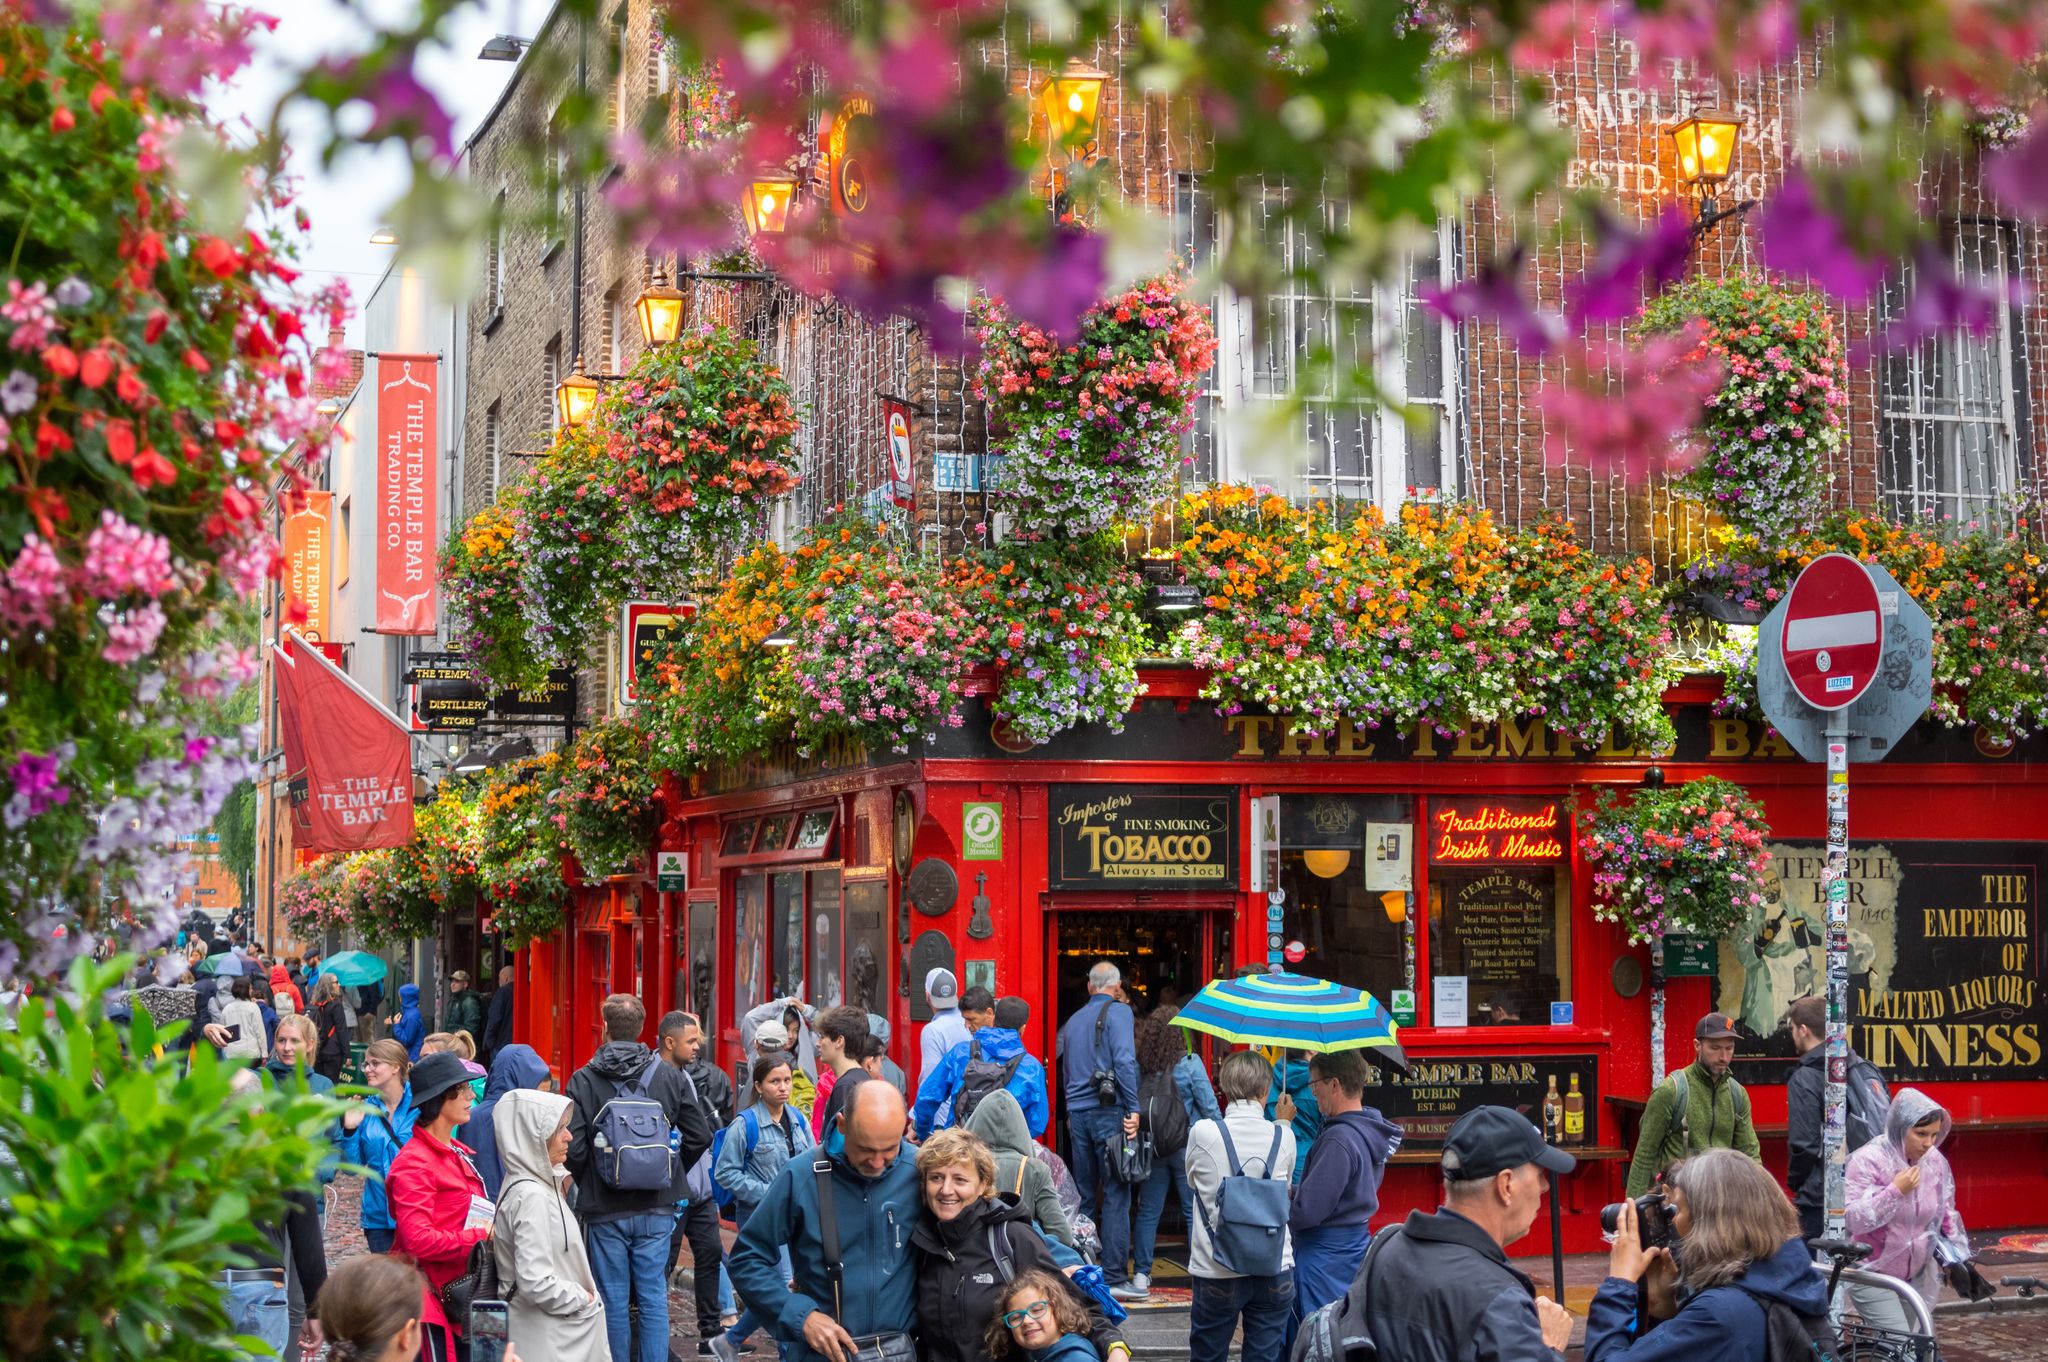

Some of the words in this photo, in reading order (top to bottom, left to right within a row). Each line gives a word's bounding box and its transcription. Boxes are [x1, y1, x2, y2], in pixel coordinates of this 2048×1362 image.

[1566, 160, 1669, 195] ESTD.
[407, 400, 423, 443] THE
[387, 431, 401, 517] TRADING
[406, 448, 423, 534] TEMPLE
[307, 527, 320, 560] THE
[387, 522, 401, 551] CO.
[406, 540, 423, 582] BAR
[306, 564, 320, 628] TEMPLE
[415, 669, 436, 678] THE
[438, 669, 471, 679] TEMPL
[429, 700, 488, 710] DISTILLERY
[441, 716, 476, 725] STORE
[1227, 715, 1377, 759] THE
[1410, 716, 1677, 760] TEML
[1706, 719, 1796, 760] BA
[342, 777, 380, 792] THE
[318, 785, 407, 811] TEMPLE
[1057, 794, 1132, 825] Importers
[341, 807, 388, 825] BAR
[1104, 812, 1118, 822] OF
[1124, 819, 1152, 831] FINE
[1154, 819, 1211, 831] SMOKING
[1439, 805, 1557, 833] Traditional
[968, 847, 996, 855] Member
[1078, 825, 1212, 873] TOBACCO
[1436, 834, 1490, 859] Irish
[1501, 834, 1562, 858] Music
[1105, 865, 1156, 877] Always
[1163, 865, 1176, 875] in
[1182, 864, 1222, 875] Stock
[1458, 875, 1513, 901] TEMPLE
[1517, 878, 1542, 901] BAR
[1813, 882, 1868, 906] BR
[1982, 874, 2027, 904] THE
[1458, 902, 1501, 911] Traditional
[1504, 902, 1523, 911] Food
[1525, 902, 1543, 911] Fare
[1463, 915, 1479, 923] Meat
[1500, 914, 1522, 923] Cheese
[1455, 926, 1473, 934] Fresh
[1474, 926, 1499, 936] Oysters,
[1501, 926, 1525, 934] Smoked
[1527, 926, 1551, 935] Salmon
[1923, 908, 2028, 938] EMPEROR
[1463, 937, 1500, 945] Charcuterie
[1523, 937, 1543, 945] Olives
[1472, 948, 1497, 957] Toasted
[1498, 948, 1534, 956] Sandwiches
[1470, 959, 1483, 968] Hot
[1484, 959, 1502, 968] Roast
[1503, 959, 1518, 968] Beef
[1520, 959, 1536, 968] Rolls
[2002, 943, 2028, 972] OF
[1855, 988, 1945, 1020] MALTED
[1948, 974, 2037, 1014] LIQUORS
[1847, 1023, 2042, 1068] UINNESS
[1490, 1062, 1539, 1085] BAR
[1412, 1087, 1461, 1100] DUBLIN
[1417, 1102, 1435, 1111] EST.
[1439, 1102, 1456, 1111] 1840
[1417, 1123, 1449, 1134] MUSIC
